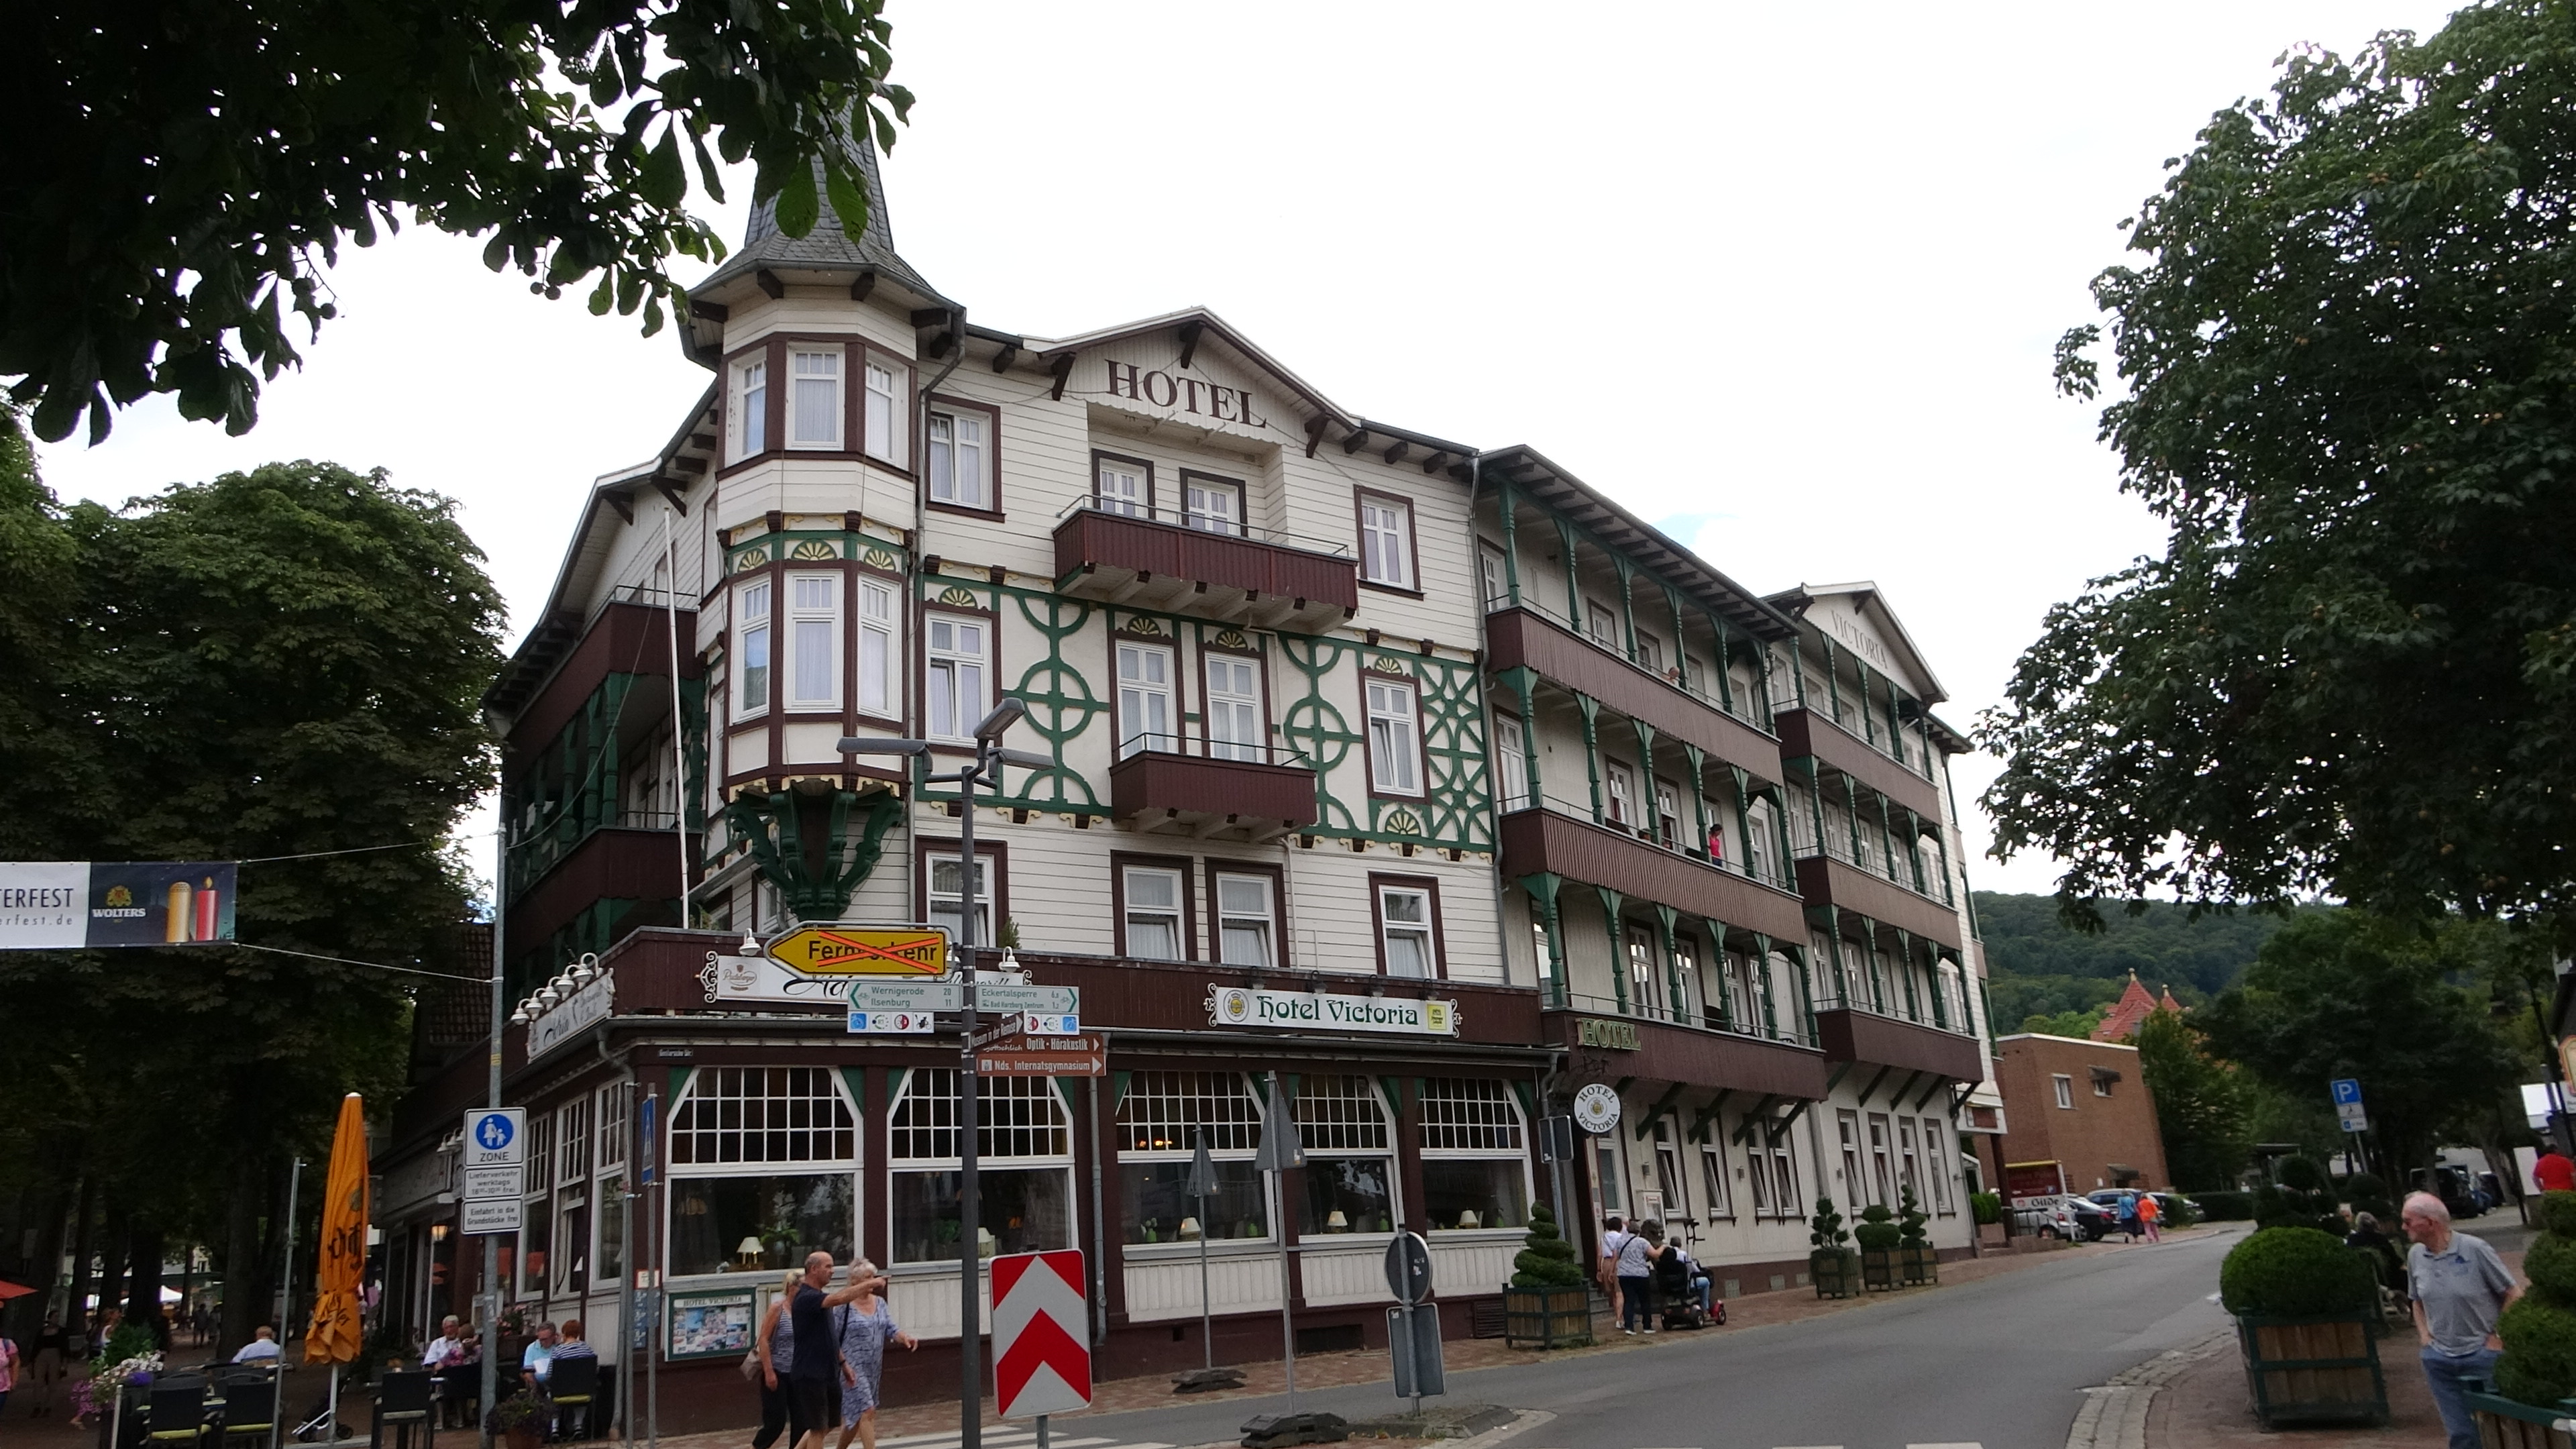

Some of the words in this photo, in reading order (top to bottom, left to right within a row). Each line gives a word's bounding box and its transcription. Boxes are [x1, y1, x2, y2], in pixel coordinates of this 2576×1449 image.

[1105, 359, 1267, 429] HOTEL
[1831, 610, 1888, 669] VICTORIA
[0, 888, 74, 908] ERFEST
[93, 908, 146, 918] WOLTERS
[871, 987, 924, 996] Wernigerode
[982, 989, 1037, 998] Eckertalsperre
[871, 999, 910, 1008] Ilsenburg
[1327, 1000, 1418, 1025] Victoria
[1575, 1018, 1641, 1051] HOTEL
[1026, 1038, 1045, 1051] Optik
[1051, 1038, 1087, 1051] Hörakustik
[995, 1061, 1011, 1071] Nds.
[1014, 1061, 1090, 1072] Internatsgymnasium
[1578, 1085, 1617, 1104] HOTEL
[2338, 1083, 2352, 1102] P
[1578, 1112, 1618, 1130] VICTORIA
[480, 1152, 509, 1162] ZONE
[2031, 1197, 2059, 1207] Gilde
[684, 1299, 706, 1307] HOTEL
[710, 1296, 742, 1304] VICTORIA
